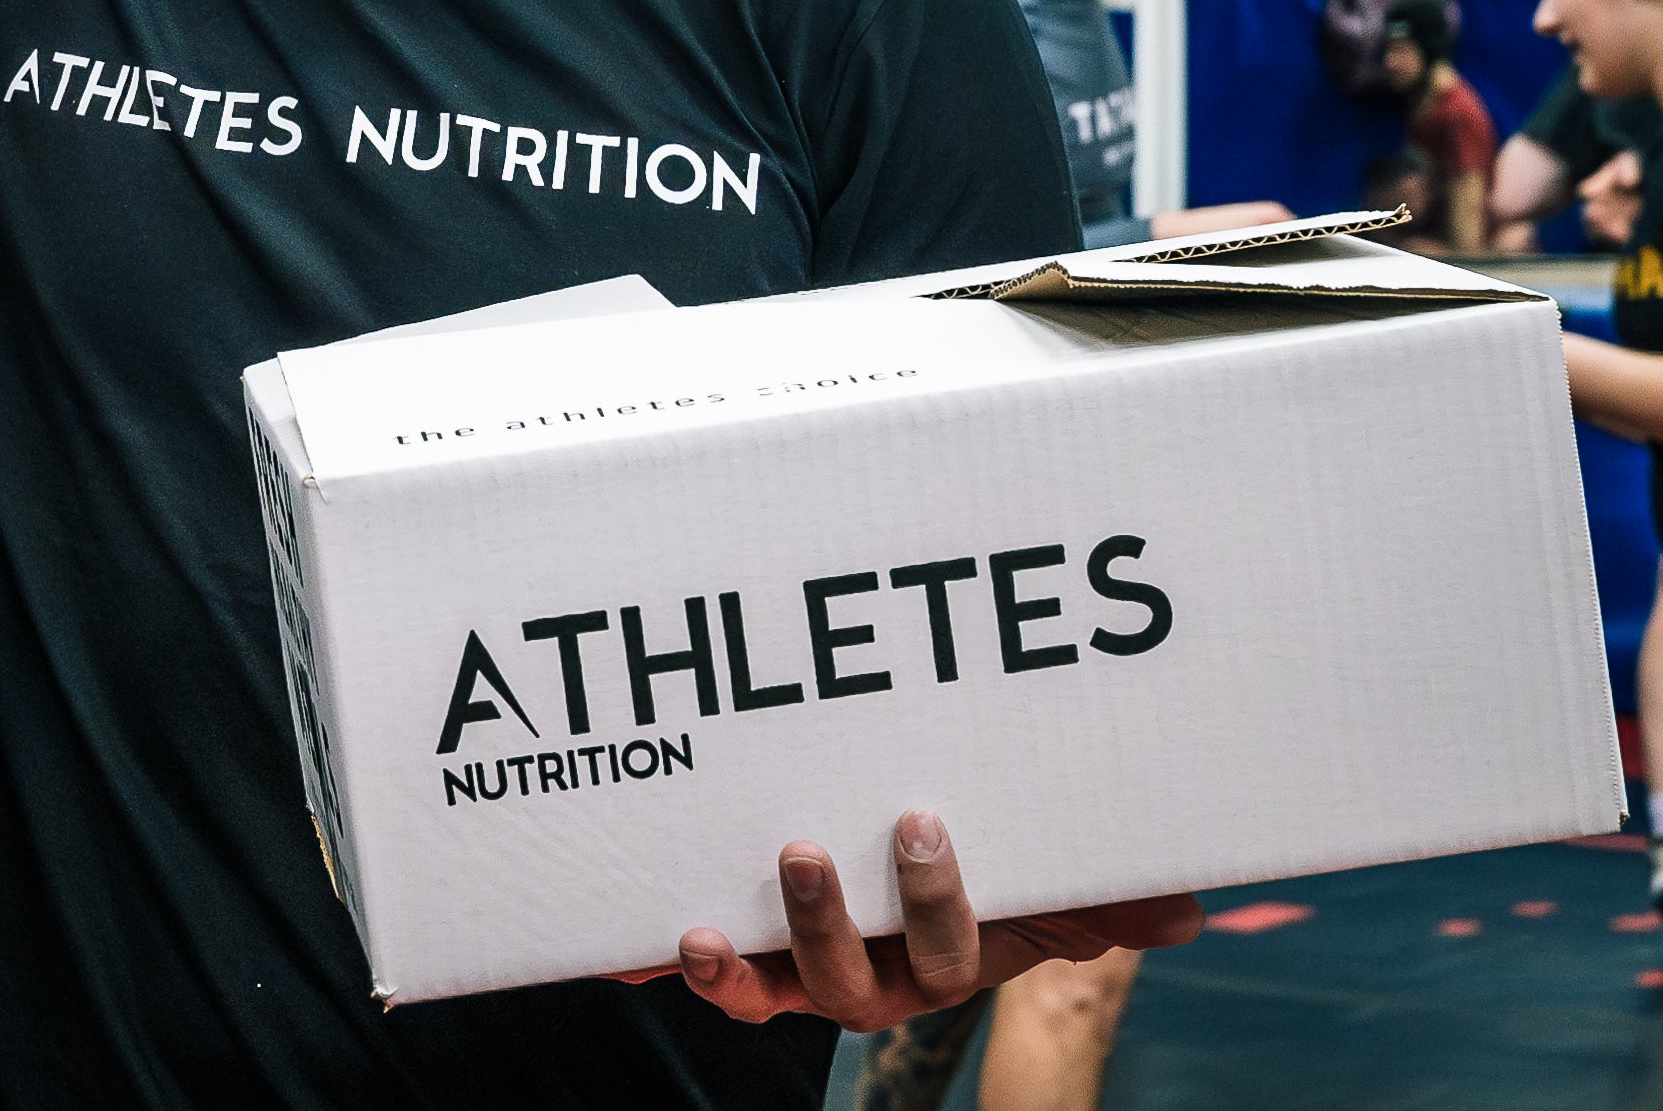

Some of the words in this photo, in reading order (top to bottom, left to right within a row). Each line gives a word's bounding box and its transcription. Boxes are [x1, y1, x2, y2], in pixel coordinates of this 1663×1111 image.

[3, 48, 303, 157] ATHLETES
[345, 104, 761, 216] NUTRITION
[393, 427, 475, 445] the
[506, 393, 726, 431] athletes
[436, 534, 1173, 755] ATHLETES
[442, 732, 694, 807] NUTRITION
